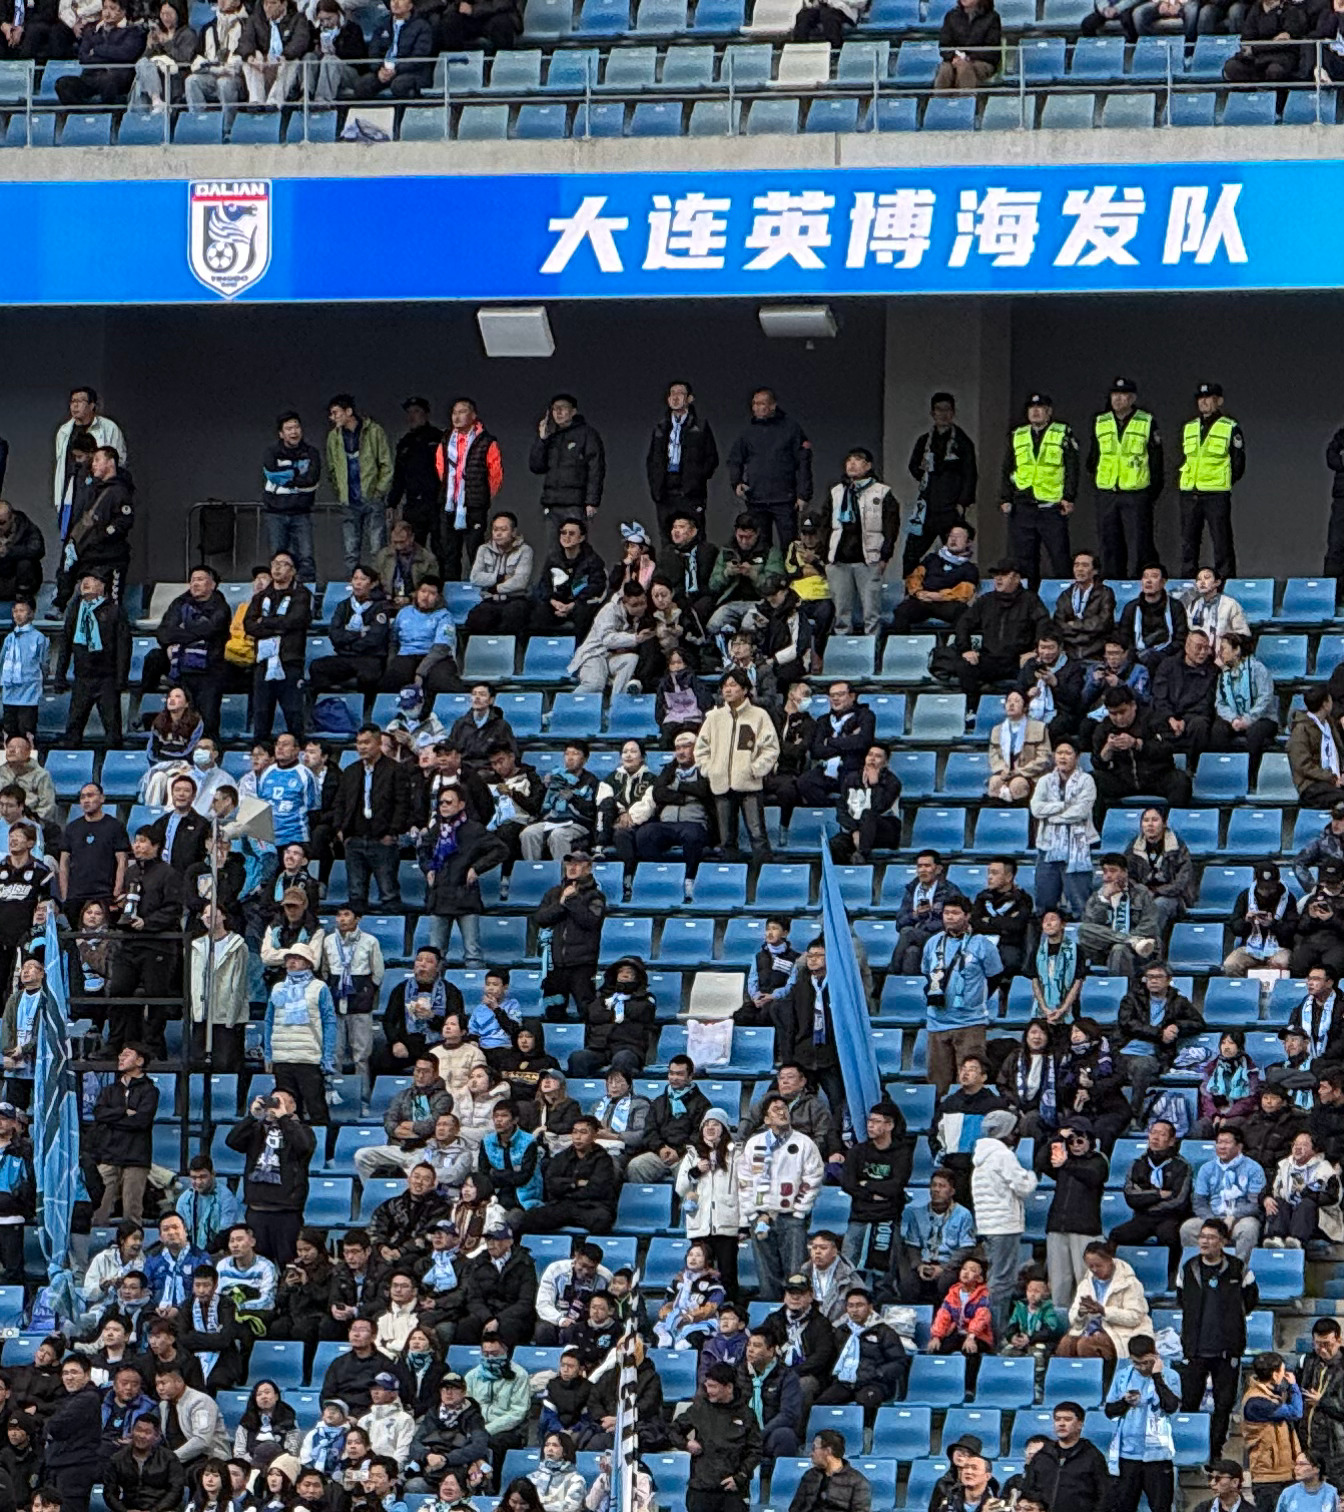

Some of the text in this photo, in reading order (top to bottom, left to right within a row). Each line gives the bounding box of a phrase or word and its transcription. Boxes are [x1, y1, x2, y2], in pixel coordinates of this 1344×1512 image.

[540, 183, 1250, 275] 大连英博海发队
